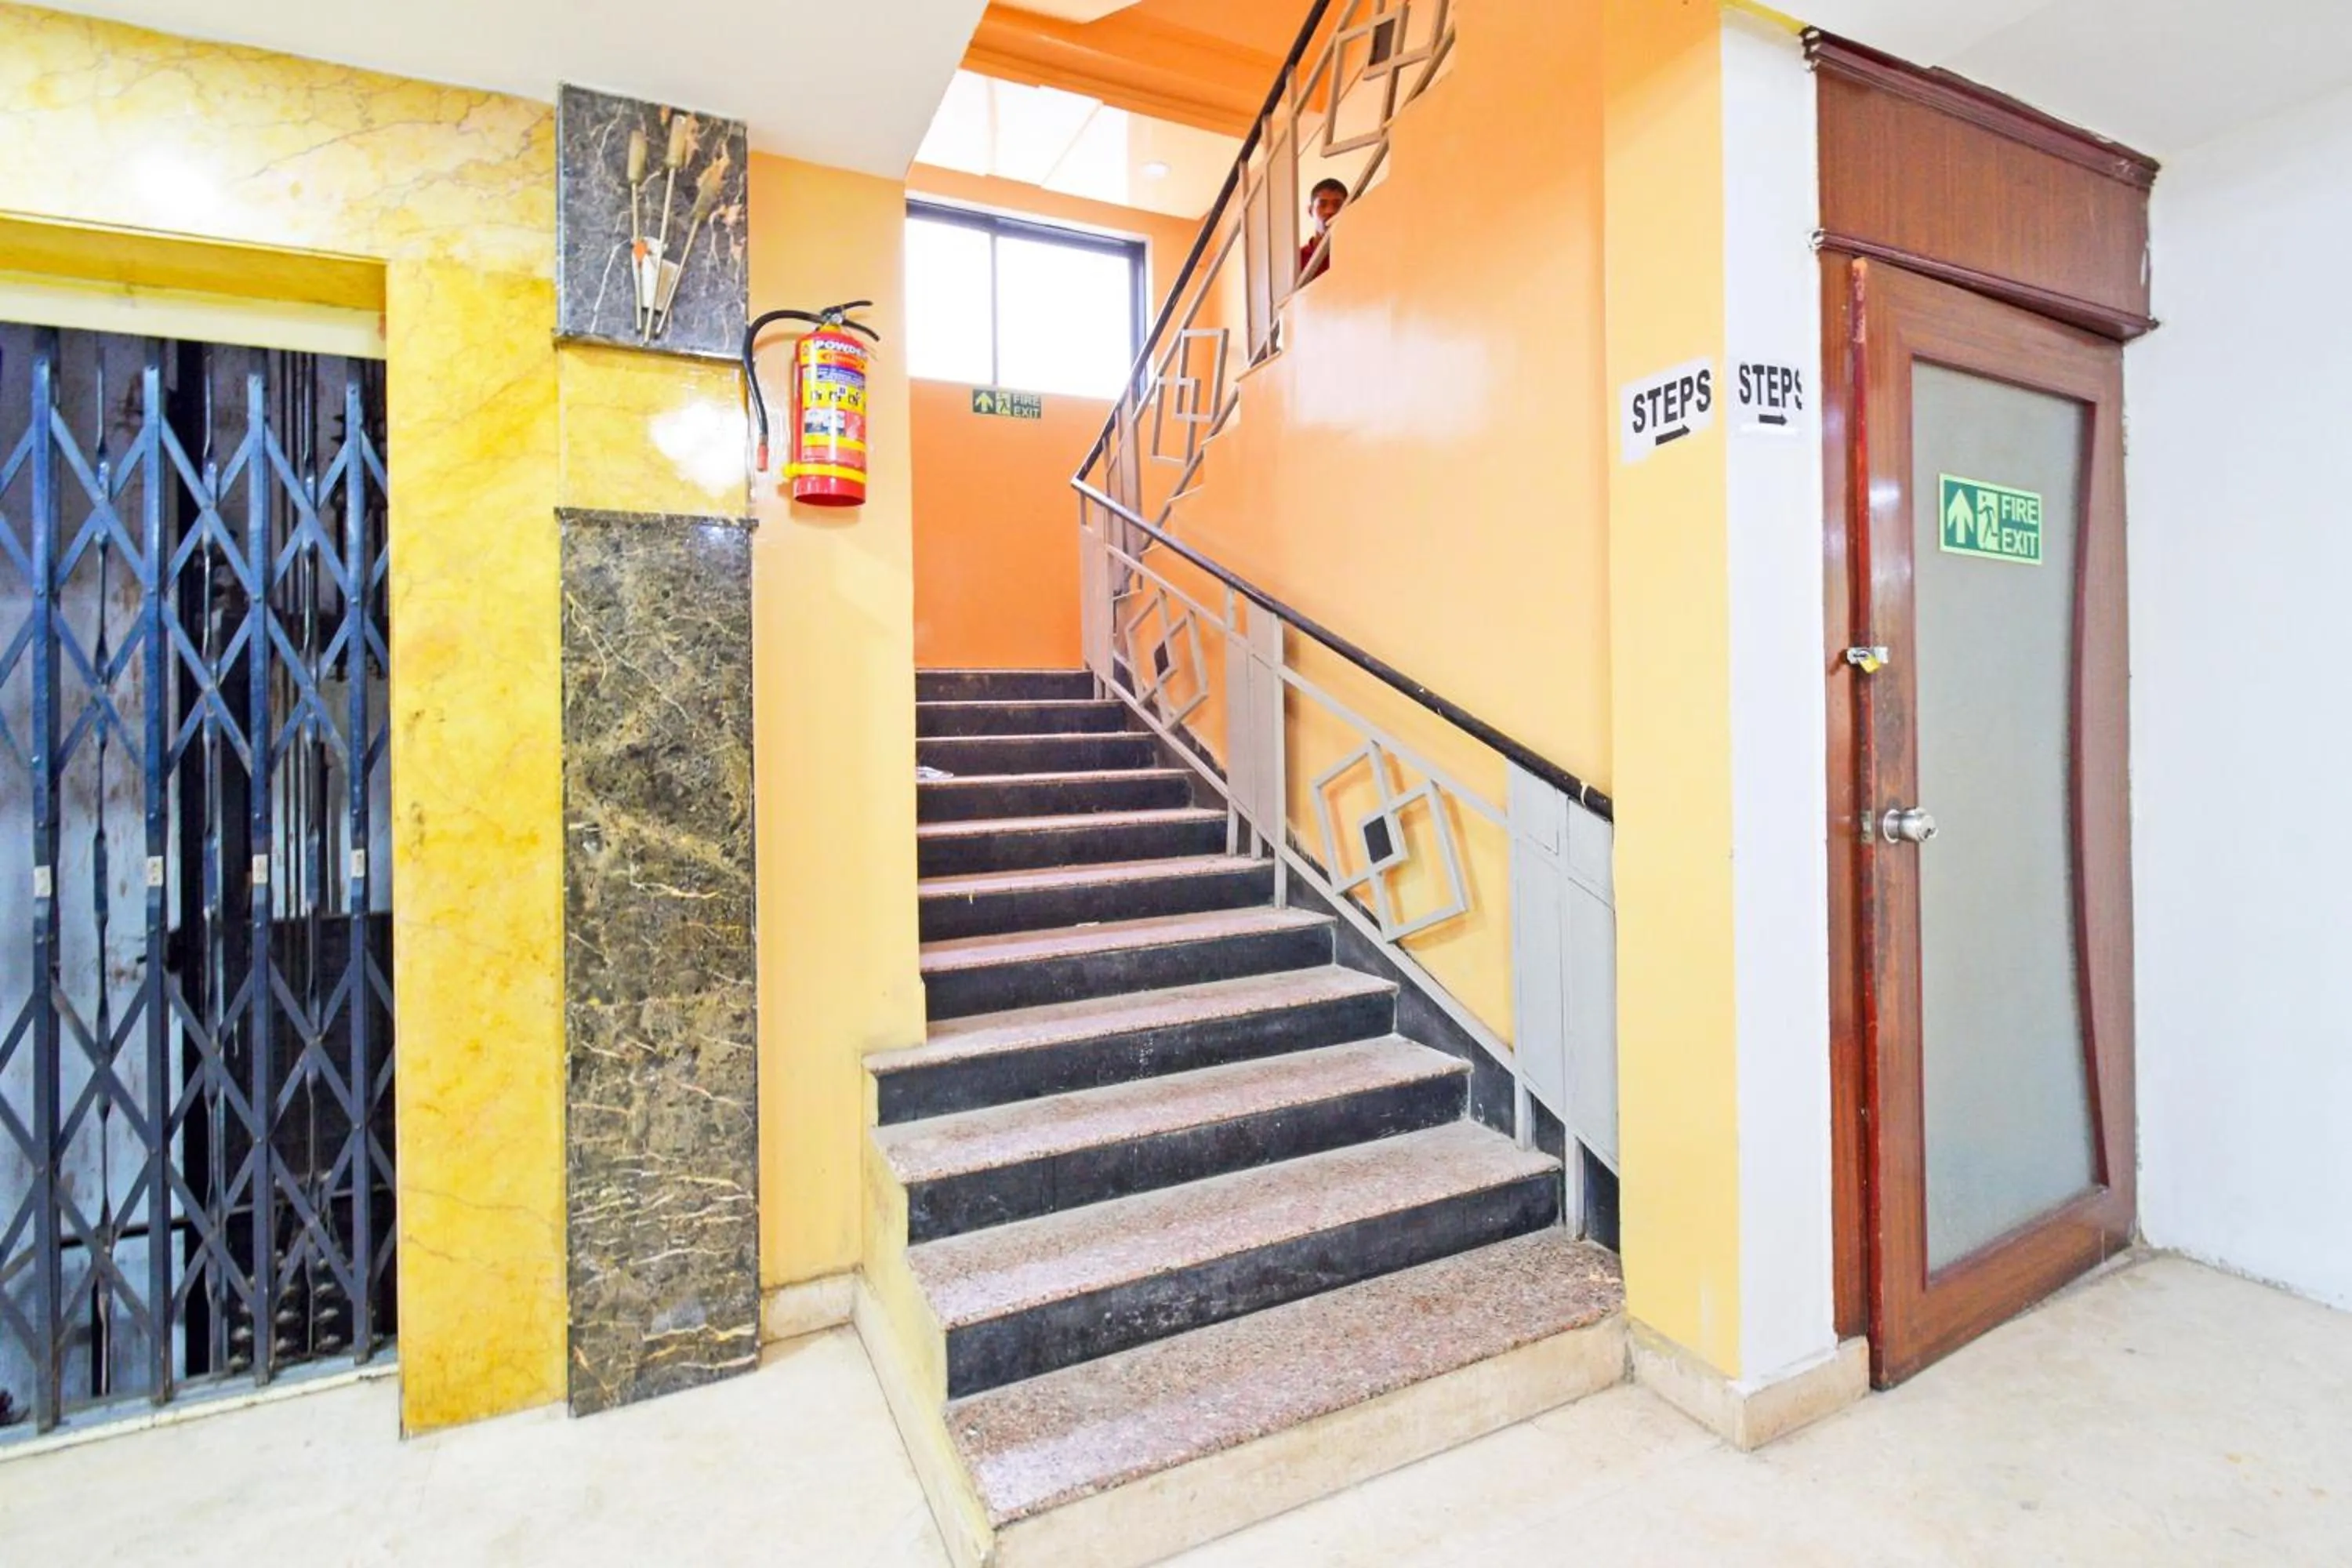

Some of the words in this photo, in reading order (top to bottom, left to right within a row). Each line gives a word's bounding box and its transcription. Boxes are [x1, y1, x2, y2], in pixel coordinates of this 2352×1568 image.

[1013, 394, 1041, 406] FIRE
[1014, 405, 1040, 419] EXIT
[1632, 368, 1711, 434] STEPS
[2002, 495, 2038, 525] FIRE
[2002, 527, 2038, 557] EXIT
